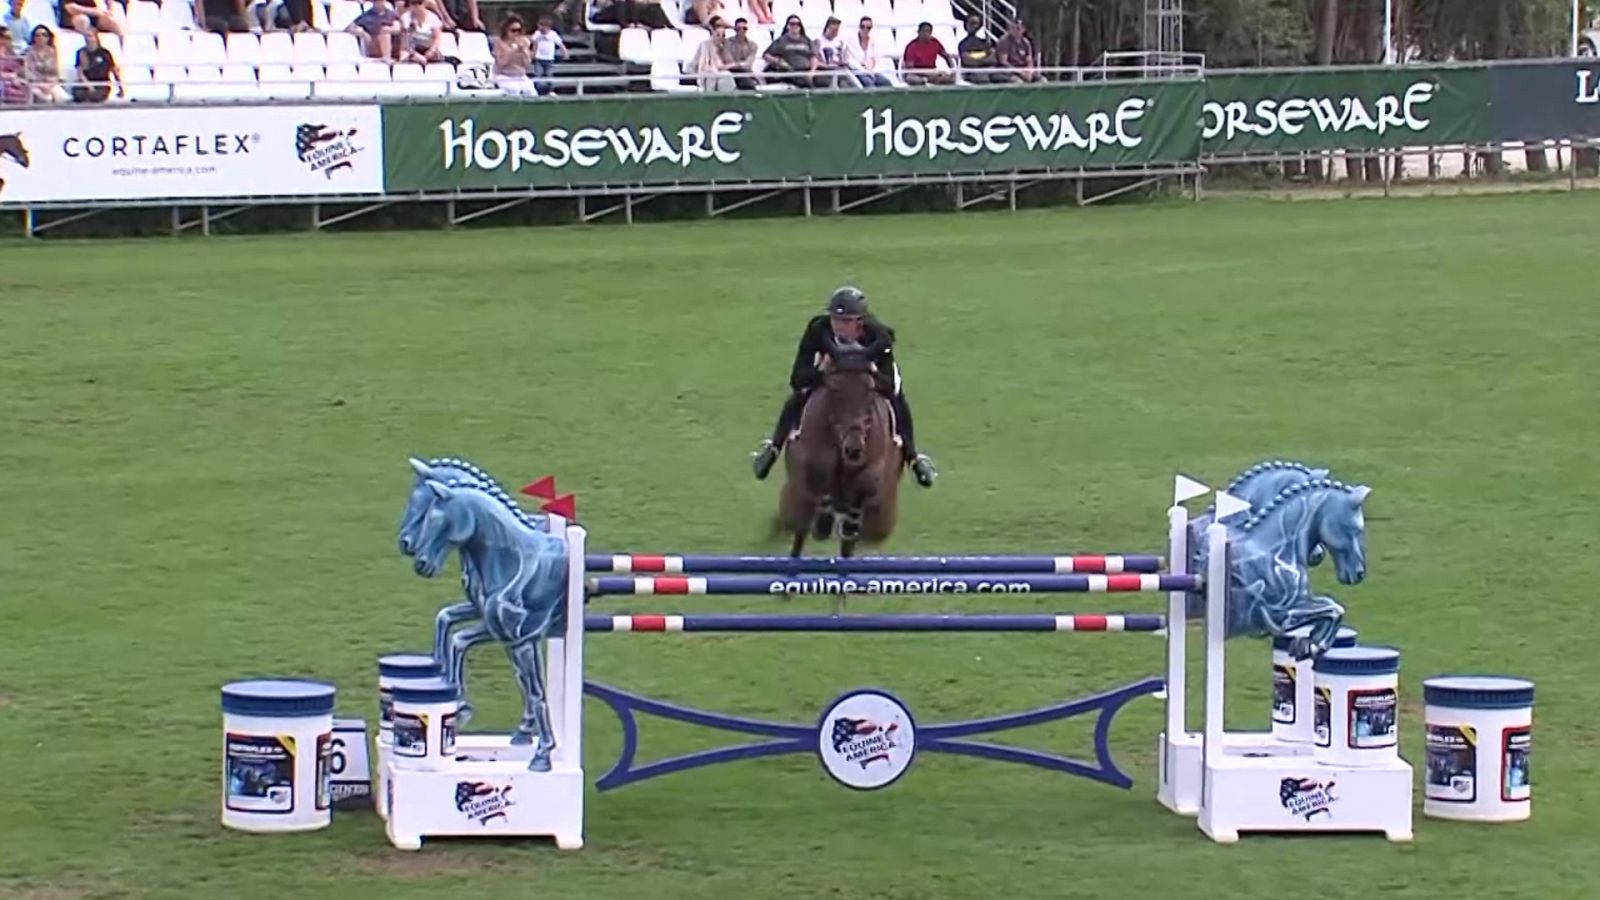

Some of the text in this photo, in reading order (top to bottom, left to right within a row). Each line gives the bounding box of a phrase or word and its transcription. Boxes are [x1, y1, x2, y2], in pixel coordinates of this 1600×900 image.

[63, 134, 251, 158] CORTAFLEX
[439, 111, 744, 172] HORSEWARE
[860, 98, 1146, 159] HORSEWARE
